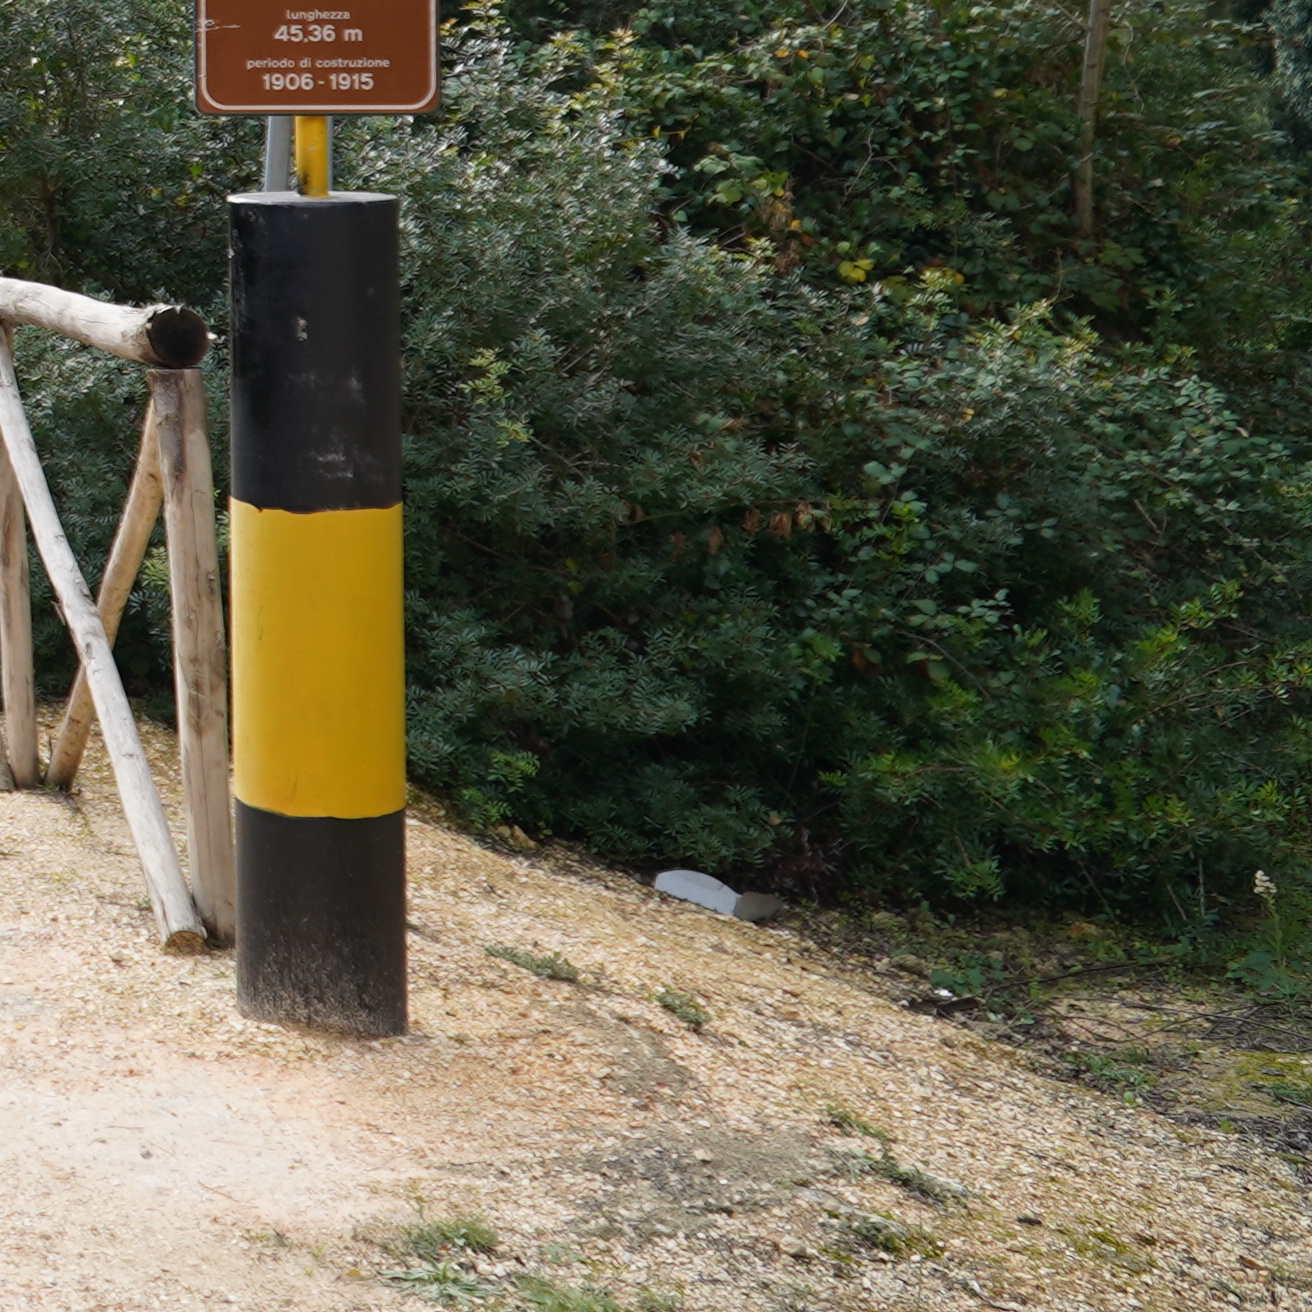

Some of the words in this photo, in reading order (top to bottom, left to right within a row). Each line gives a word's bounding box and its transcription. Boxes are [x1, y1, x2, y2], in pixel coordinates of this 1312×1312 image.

[287, 9, 351, 22] lunghezza
[273, 24, 336, 43] 45,36
[343, 28, 363, 42] m
[246, 57, 296, 70] periodo
[299, 57, 312, 69] di
[315, 57, 391, 69] costruzione
[262, 72, 314, 91] 1906
[329, 72, 374, 91] 1915
